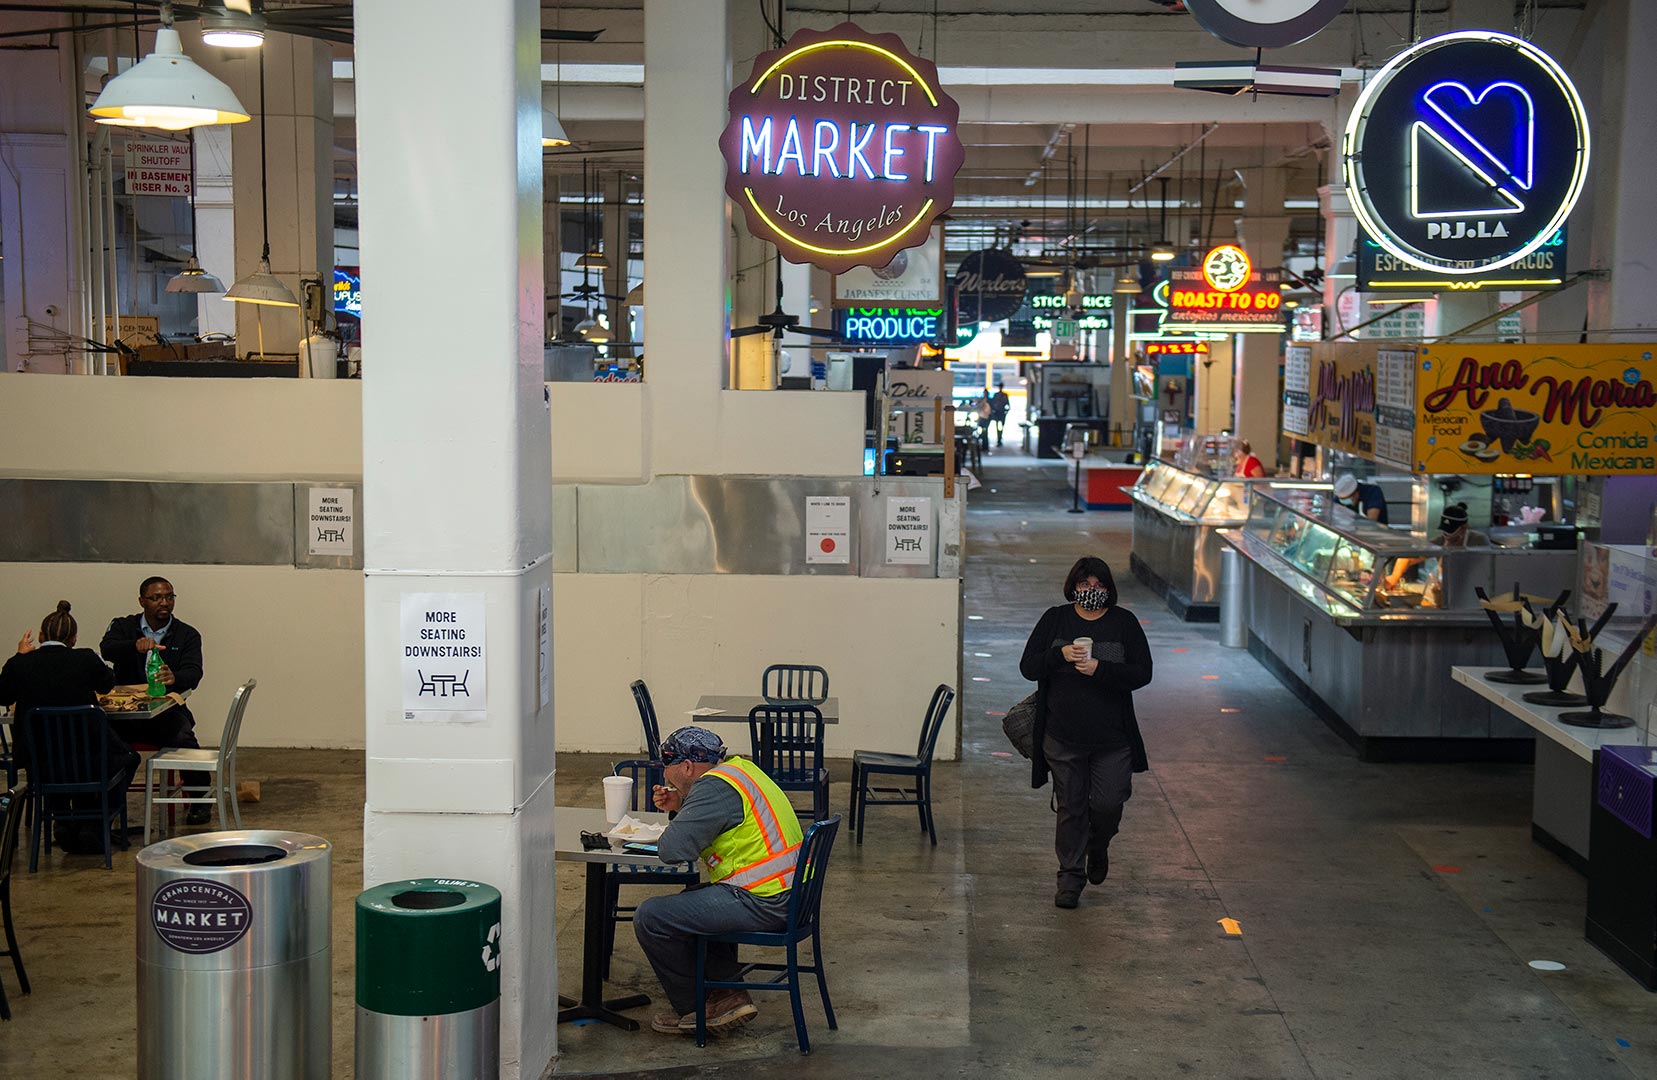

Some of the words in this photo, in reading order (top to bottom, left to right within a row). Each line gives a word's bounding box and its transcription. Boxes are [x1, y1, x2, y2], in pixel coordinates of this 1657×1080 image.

[779, 73, 913, 106] DISTRICT
[171, 145, 190, 154] VALV
[740, 116, 948, 183] MARKET
[140, 155, 181, 166] SHUTOFF
[127, 170, 137, 180] IN
[164, 183, 180, 193] No.
[183, 184, 190, 193] 3
[775, 194, 808, 227] Los
[814, 204, 903, 242] Angeles
[844, 289, 892, 298] JAPANESE
[894, 289, 933, 299] CUISINE
[1172, 291, 1227, 308] ROAST
[1229, 292, 1252, 309] TO
[1254, 292, 1281, 309] GO
[1082, 295, 1113, 308] RICE
[846, 316, 937, 339] PRODUCE
[1056, 321, 1076, 337] EXIT
[1147, 342, 1209, 355] PIZZA
[891, 382, 930, 398] Deli
[1423, 357, 1529, 413] Ana
[1529, 375, 1657, 429] Maria
[1423, 414, 1469, 425] Mexican
[1432, 425, 1462, 436] Food
[1576, 430, 1649, 449] Comida
[1570, 451, 1655, 470] Mexicana
[319, 505, 343, 513] SEATING
[311, 514, 351, 522] DOWNSTAIRS!
[425, 611, 457, 623] MORE
[420, 628, 466, 640] SEATING
[405, 645, 482, 658] DOWNSTAIRS!
[161, 885, 190, 902] GRAND
[191, 885, 234, 905] CENTRAL
[157, 908, 243, 927] MARKET
